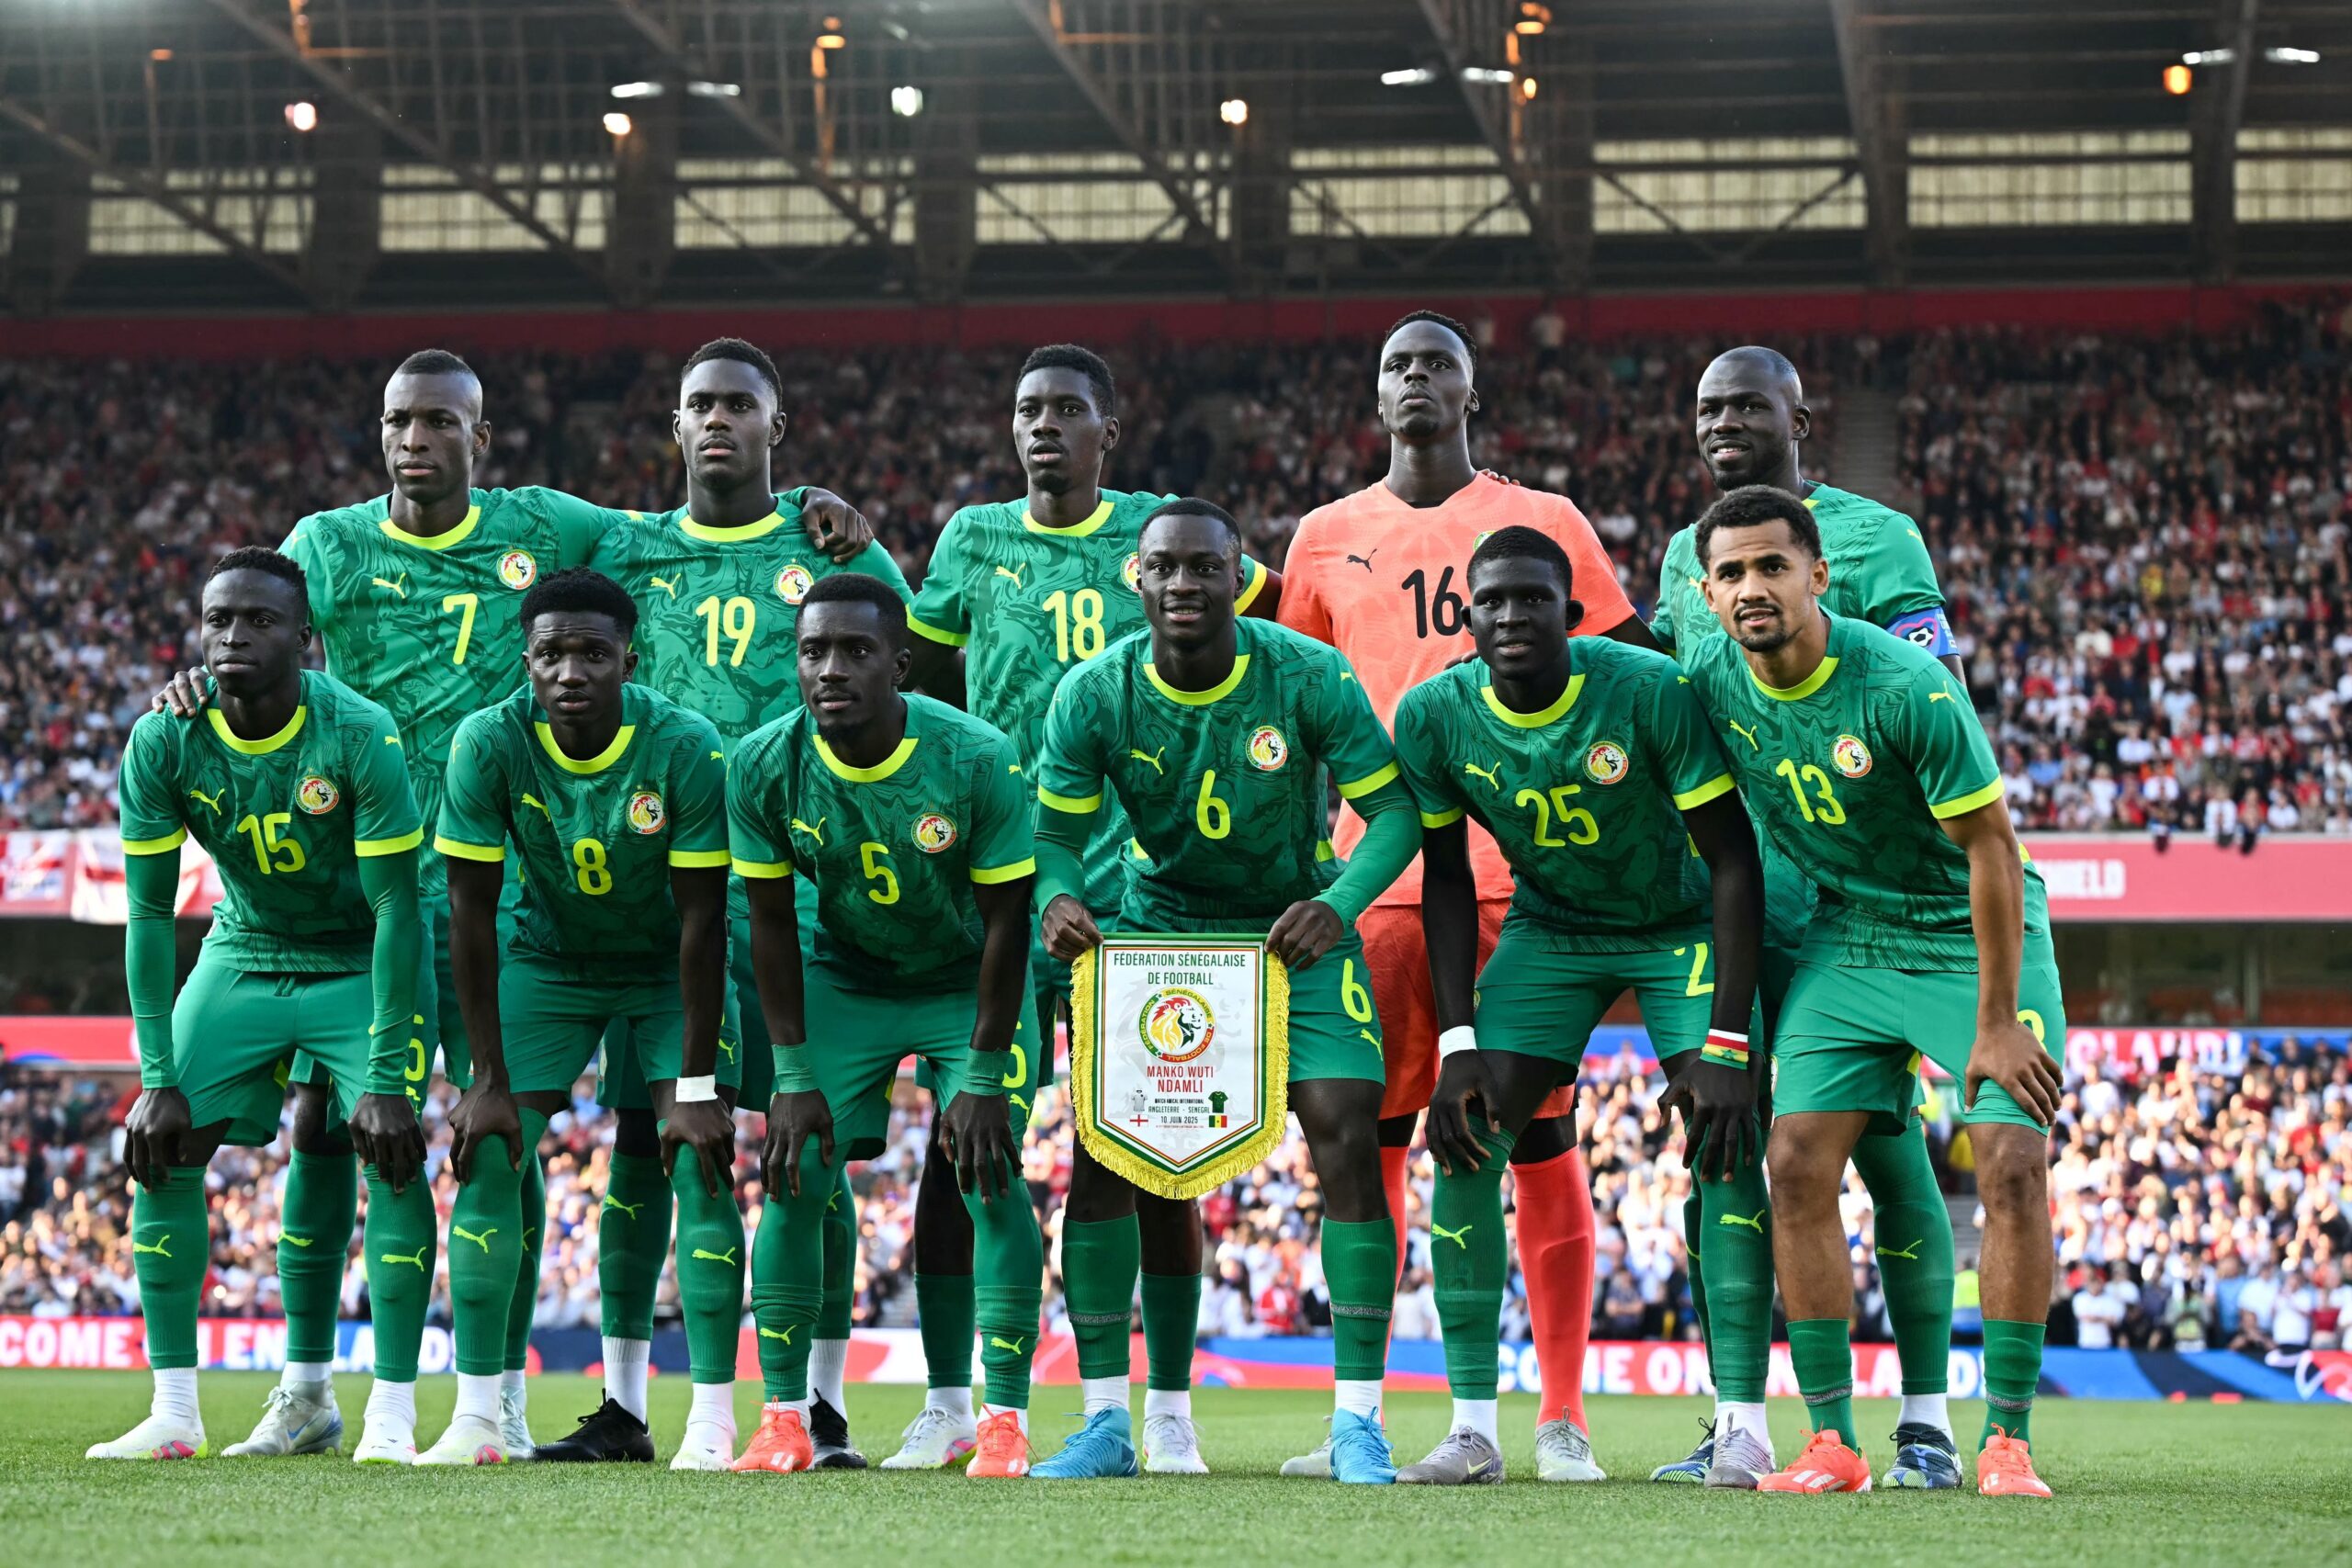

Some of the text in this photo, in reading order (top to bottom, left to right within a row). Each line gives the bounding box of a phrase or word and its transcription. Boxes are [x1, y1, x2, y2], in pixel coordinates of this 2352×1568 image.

[443, 593, 478, 666] 7
[695, 594, 755, 668] 19
[1042, 588, 1106, 661] 18
[1401, 566, 1464, 638] 16
[1196, 769, 1231, 840] 6
[1515, 784, 1600, 847] 25
[1776, 758, 1847, 826] 13
[236, 812, 306, 874] 15
[572, 837, 613, 896] 8
[860, 841, 900, 905] 5
[1114, 952, 1246, 967] FÉDÉRATION SÉNÉGALAISE
[1148, 972, 1214, 986] DE FOOTBALL
[1341, 958, 1373, 1022] 6
[1147, 1066, 1214, 1077] MANKO WUTI
[1158, 1079, 1204, 1092] NDAMLI
[1184, 1116, 1199, 1124] 2025
[0, 1319, 133, 1368] COME
